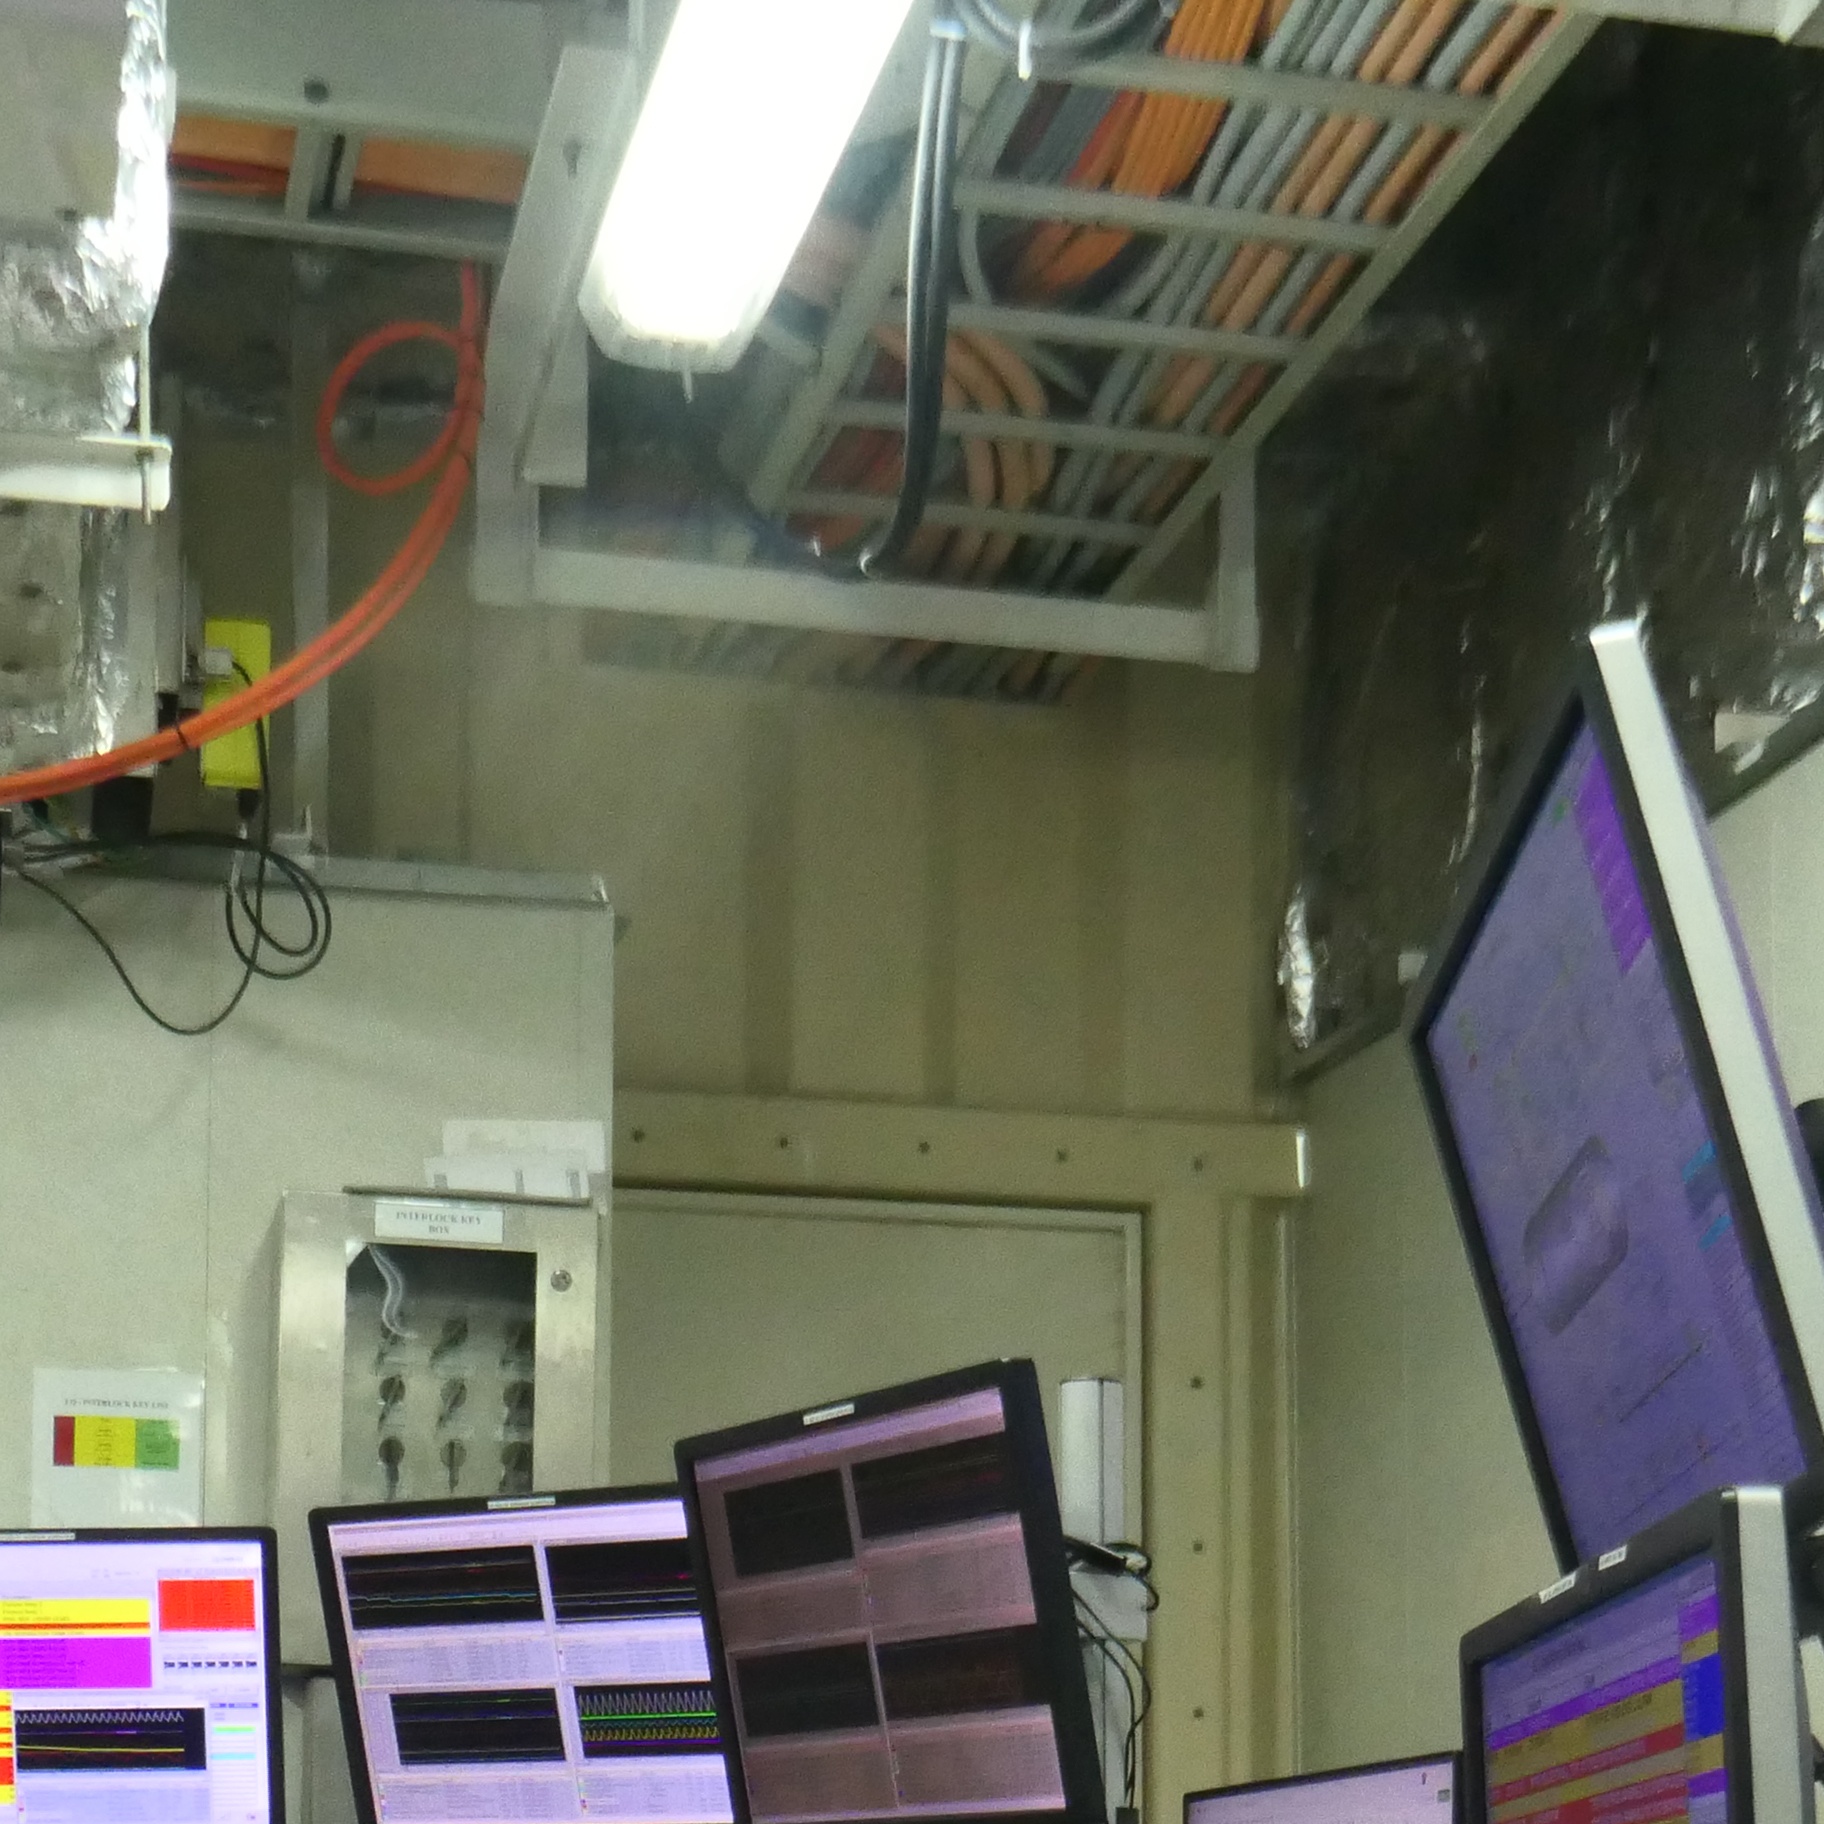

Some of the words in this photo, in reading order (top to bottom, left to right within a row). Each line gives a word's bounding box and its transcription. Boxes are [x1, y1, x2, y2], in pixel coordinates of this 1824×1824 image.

[396, 1211, 459, 1225] INTERLOCK
[461, 1215, 482, 1226] KEY
[428, 1225, 451, 1235] BOX
